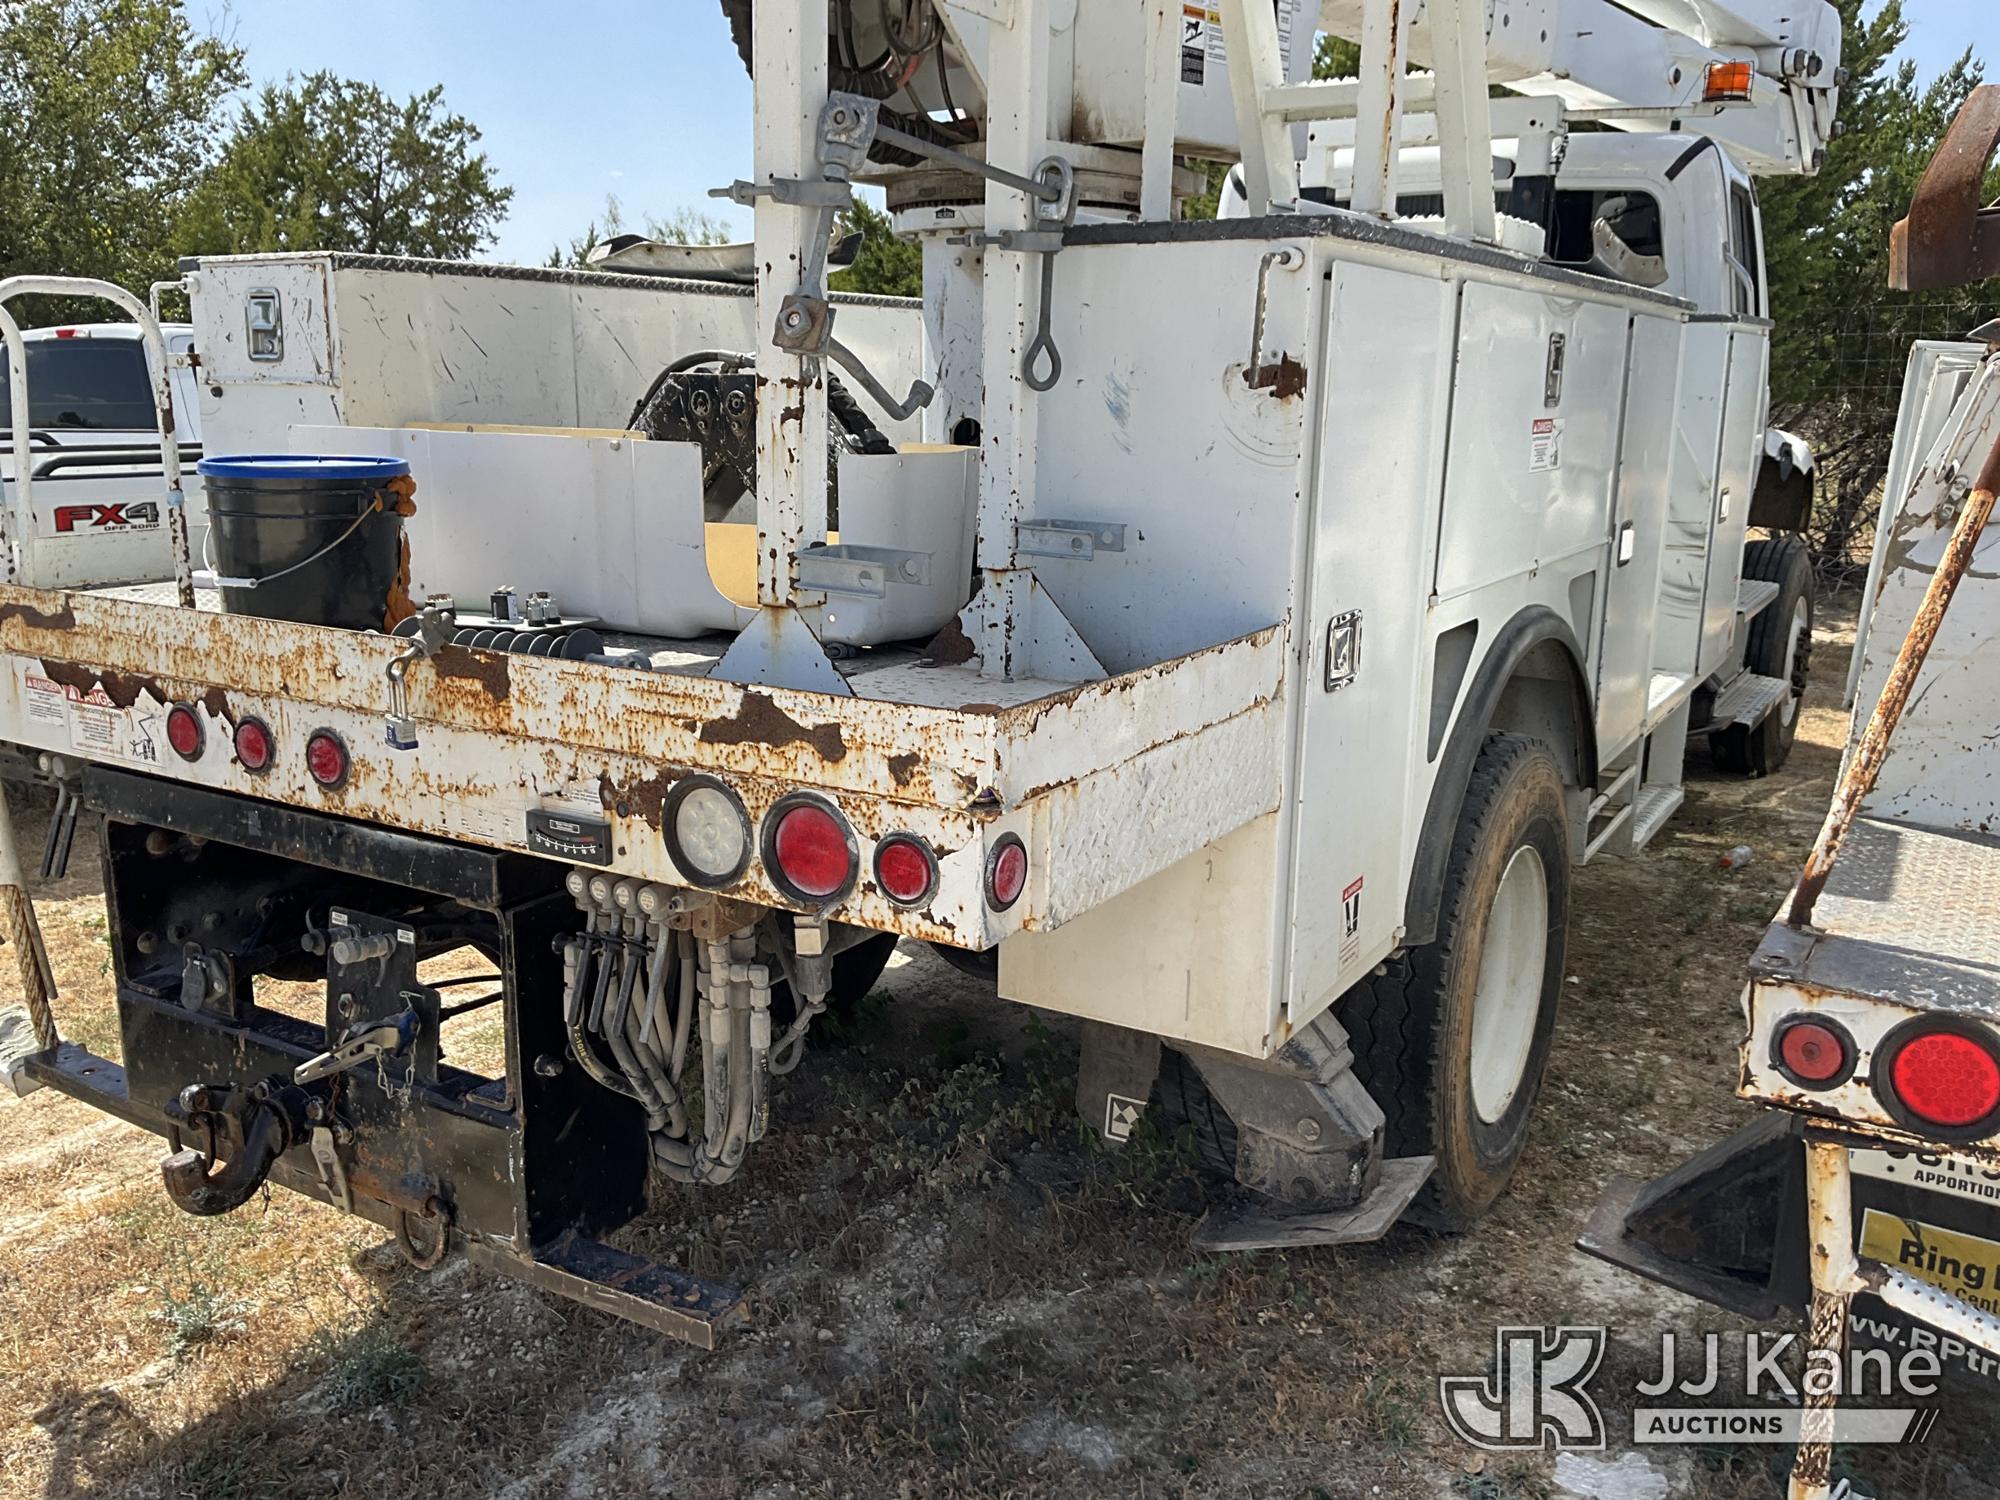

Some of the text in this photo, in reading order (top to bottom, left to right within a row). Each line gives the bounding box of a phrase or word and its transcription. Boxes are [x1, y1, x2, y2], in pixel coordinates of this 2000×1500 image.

[54, 502, 159, 532] FX4
[1899, 1238, 1986, 1290] Ring
[1954, 1287, 2000, 1313] Cent
